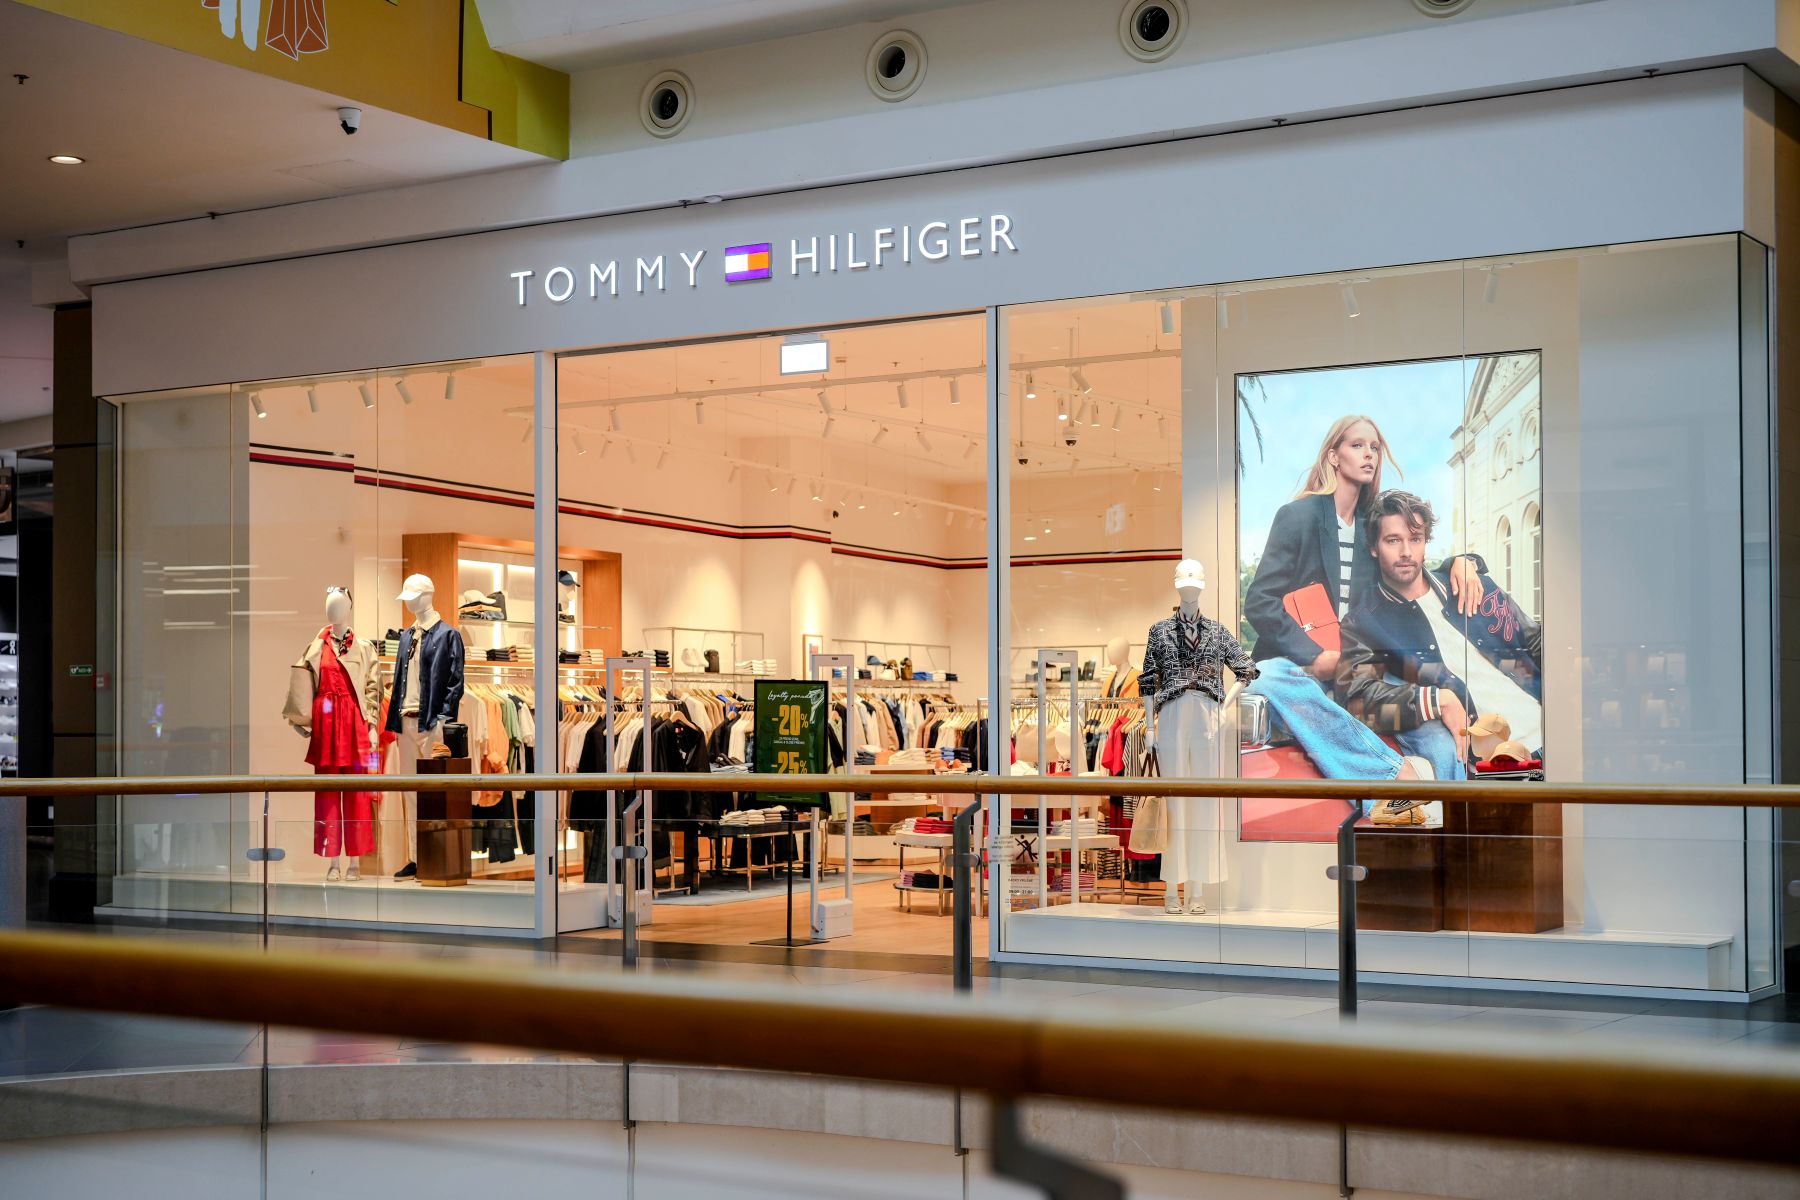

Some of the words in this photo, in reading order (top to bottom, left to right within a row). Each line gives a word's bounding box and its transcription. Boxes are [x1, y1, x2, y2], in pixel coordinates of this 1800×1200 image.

[510, 249, 707, 306] TOMMY
[790, 214, 1018, 276] HILFIGER
[771, 704, 809, 736] -20%
